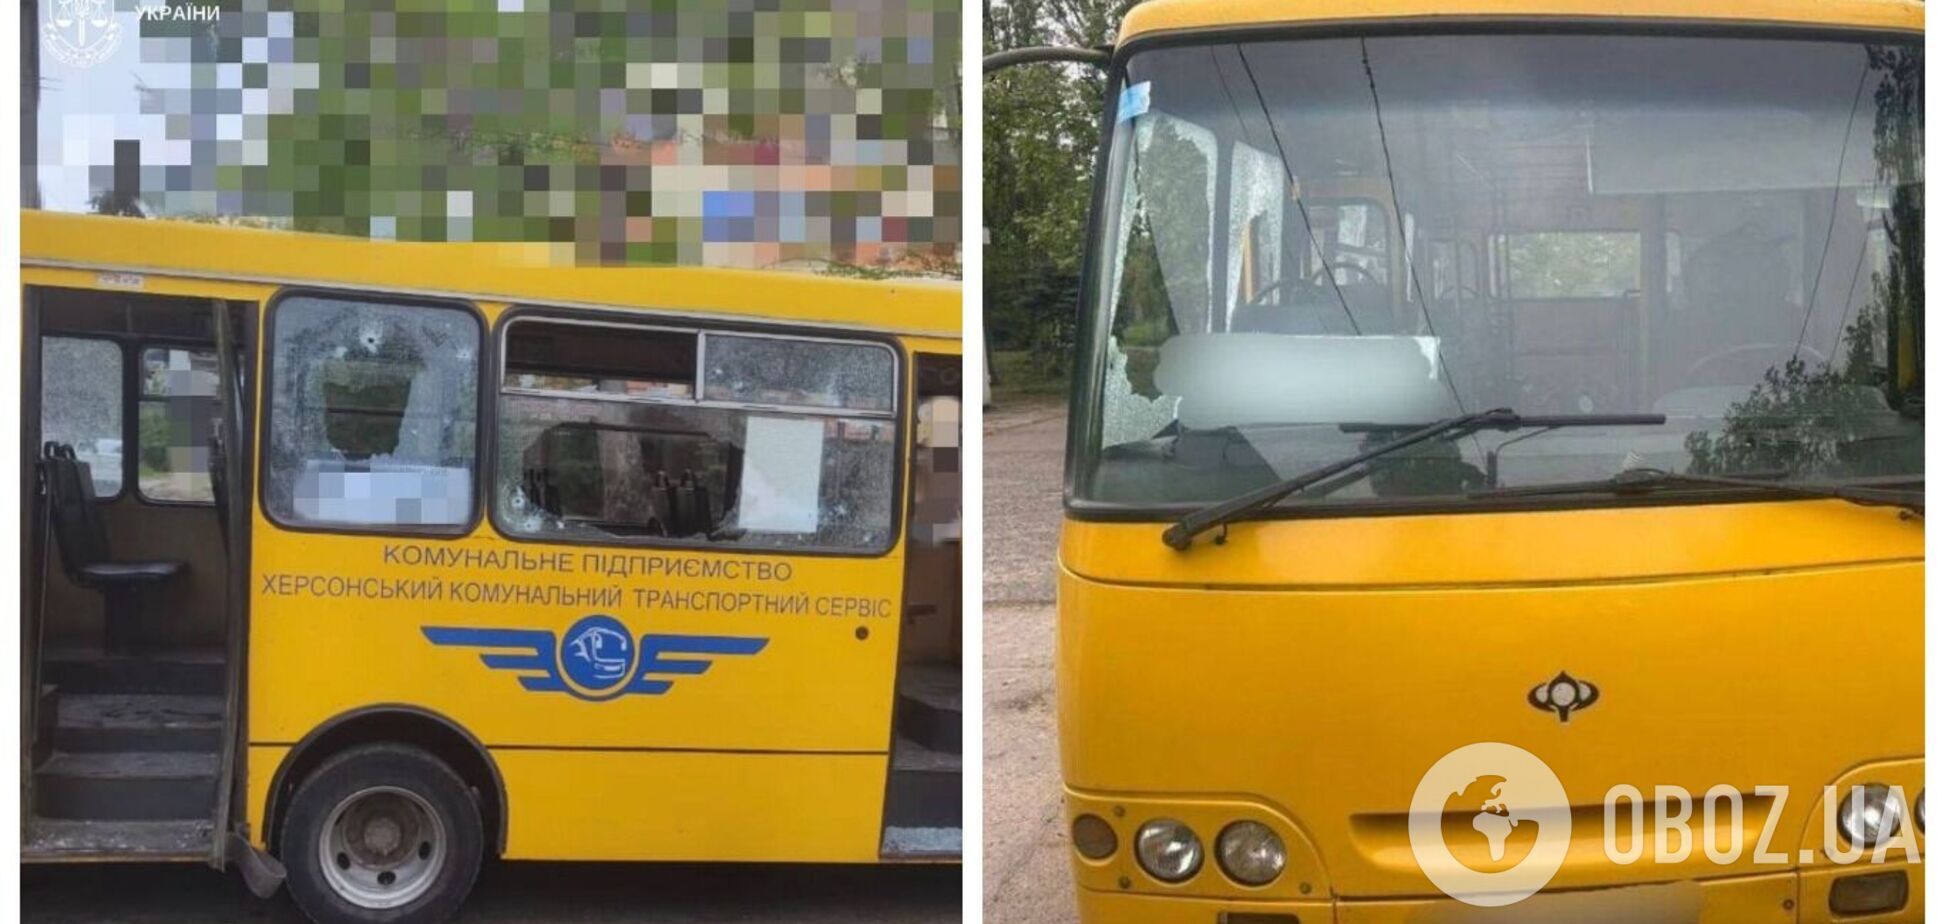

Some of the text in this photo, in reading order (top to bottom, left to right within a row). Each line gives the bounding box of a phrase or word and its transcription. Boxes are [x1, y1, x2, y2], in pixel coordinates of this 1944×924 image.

[383, 545, 792, 582] КОМУНАЛЬНЕ ПІДПРИЄМСТВО
[262, 574, 892, 618] ХЕРСОНСЬКИЙ КОМУНАЛЬНИЙ ТРАНСПОРТНИЙ СЕРВІС
